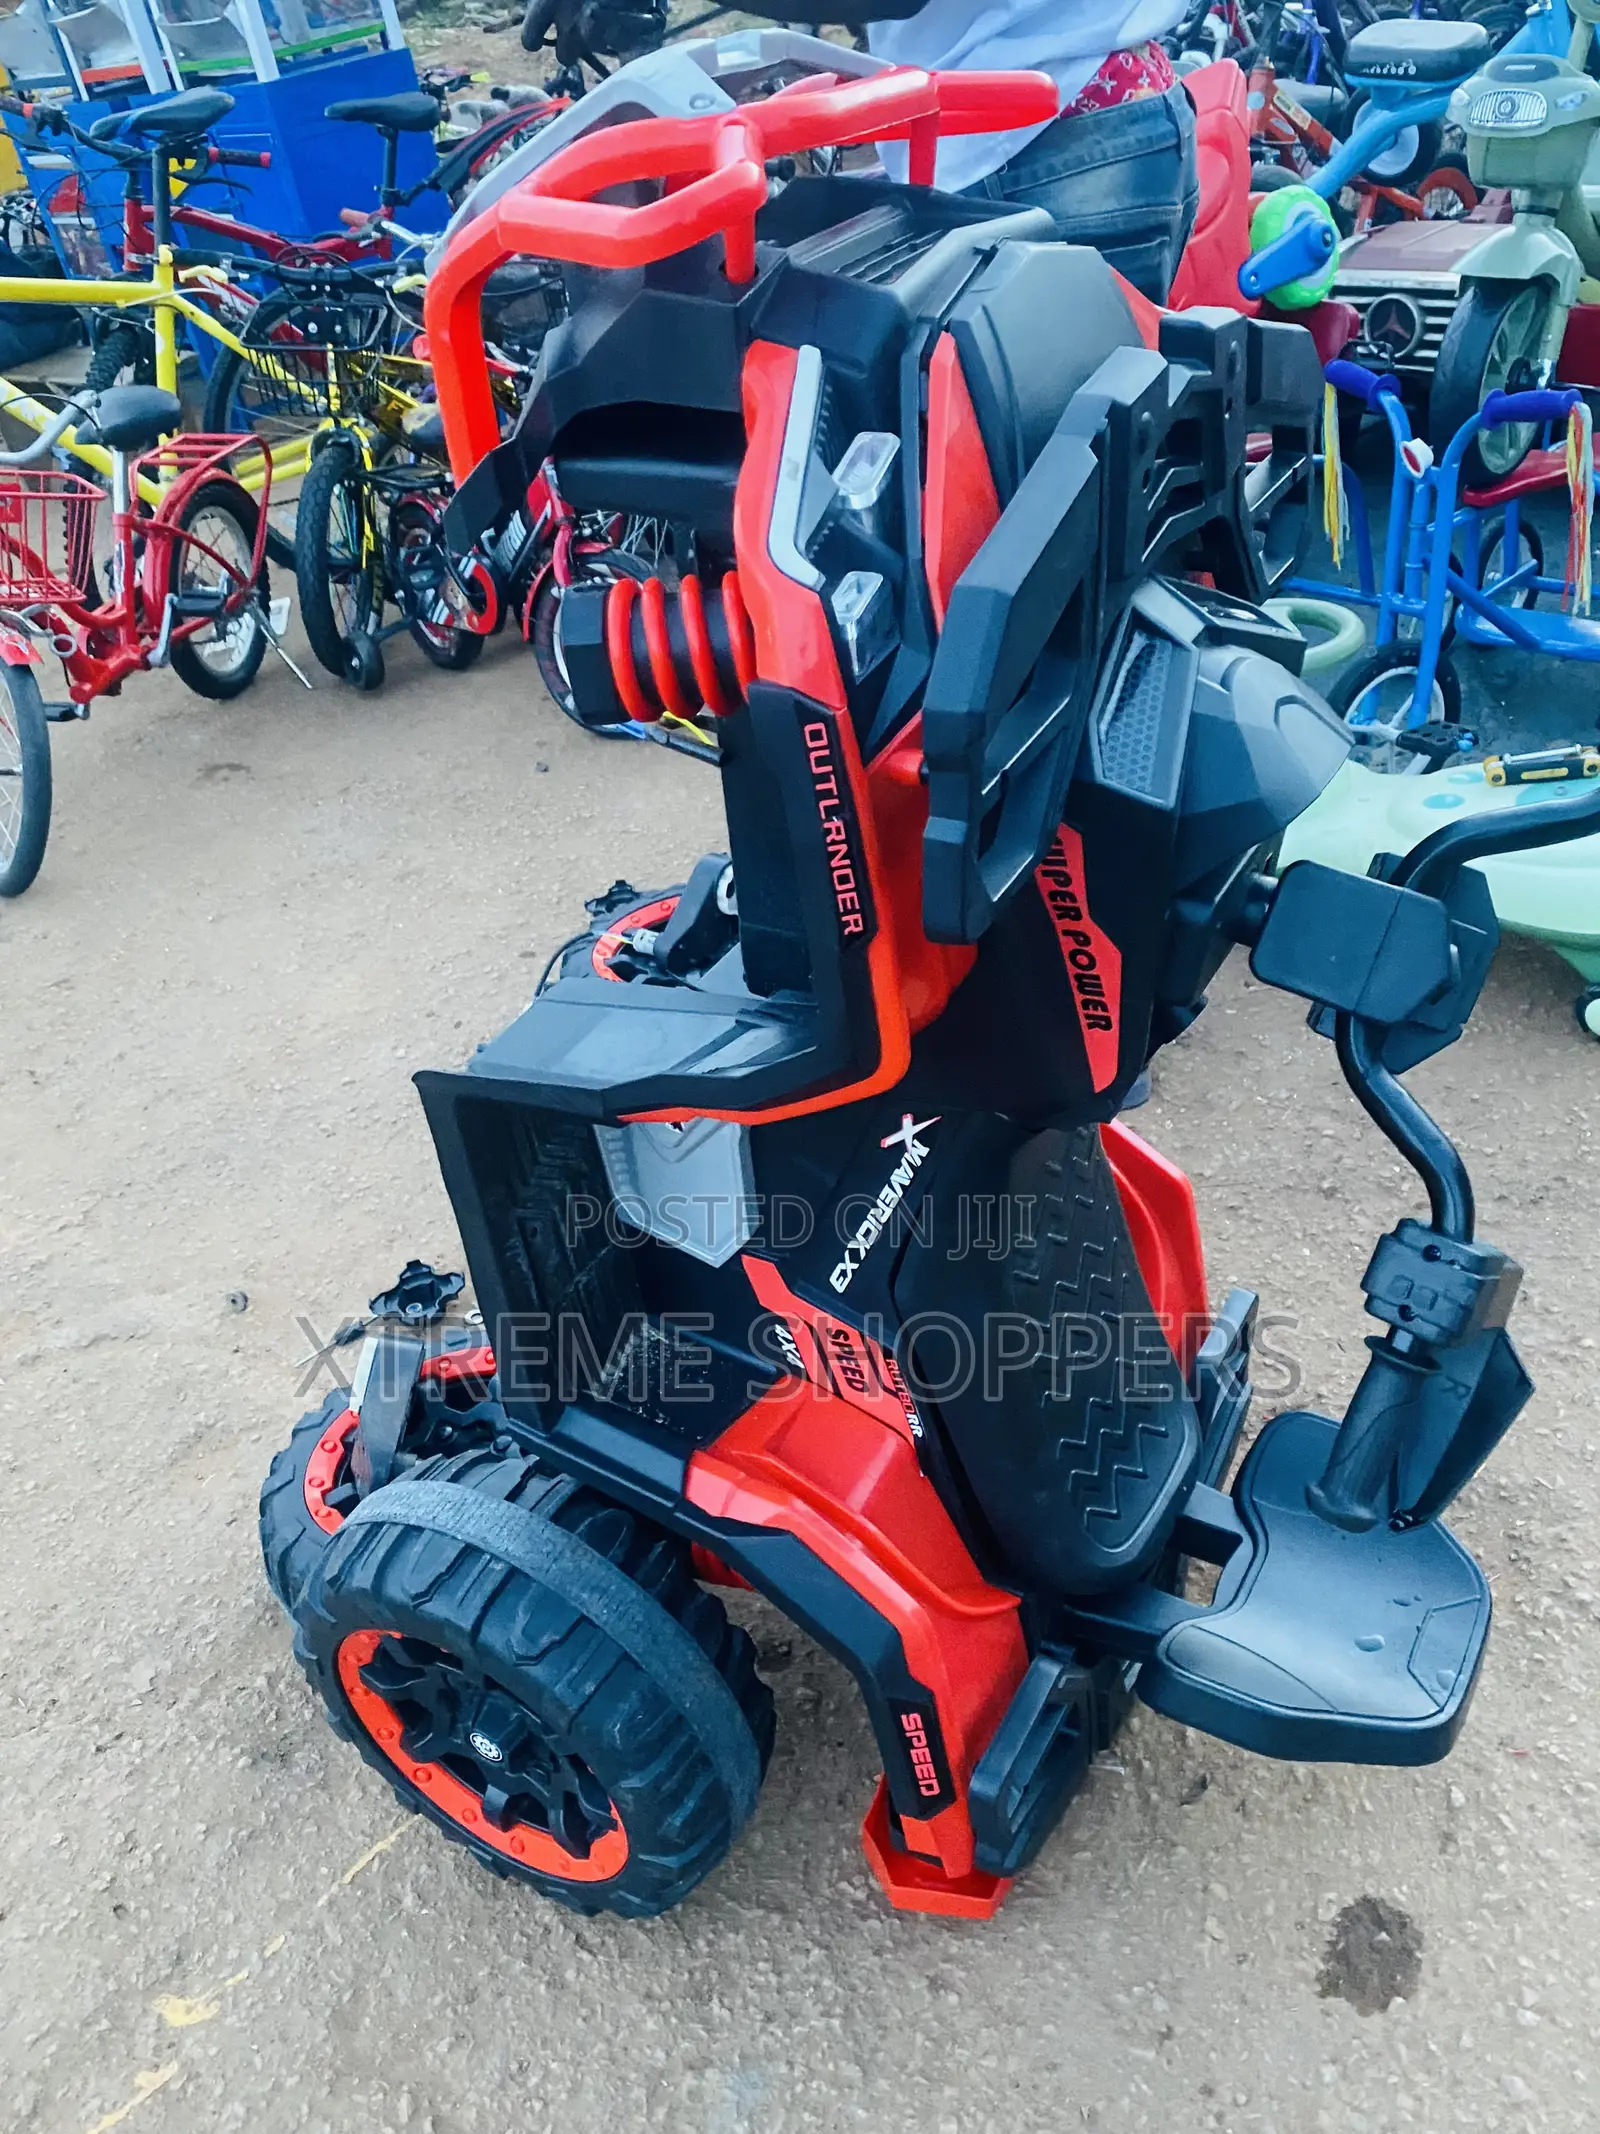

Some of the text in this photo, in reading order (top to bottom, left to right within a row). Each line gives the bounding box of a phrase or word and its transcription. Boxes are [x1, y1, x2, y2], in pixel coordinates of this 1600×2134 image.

[1061, 929, 1112, 1032] POWER
[829, 1329, 870, 1393] SPEED
[901, 1713, 940, 1797] SPEED
